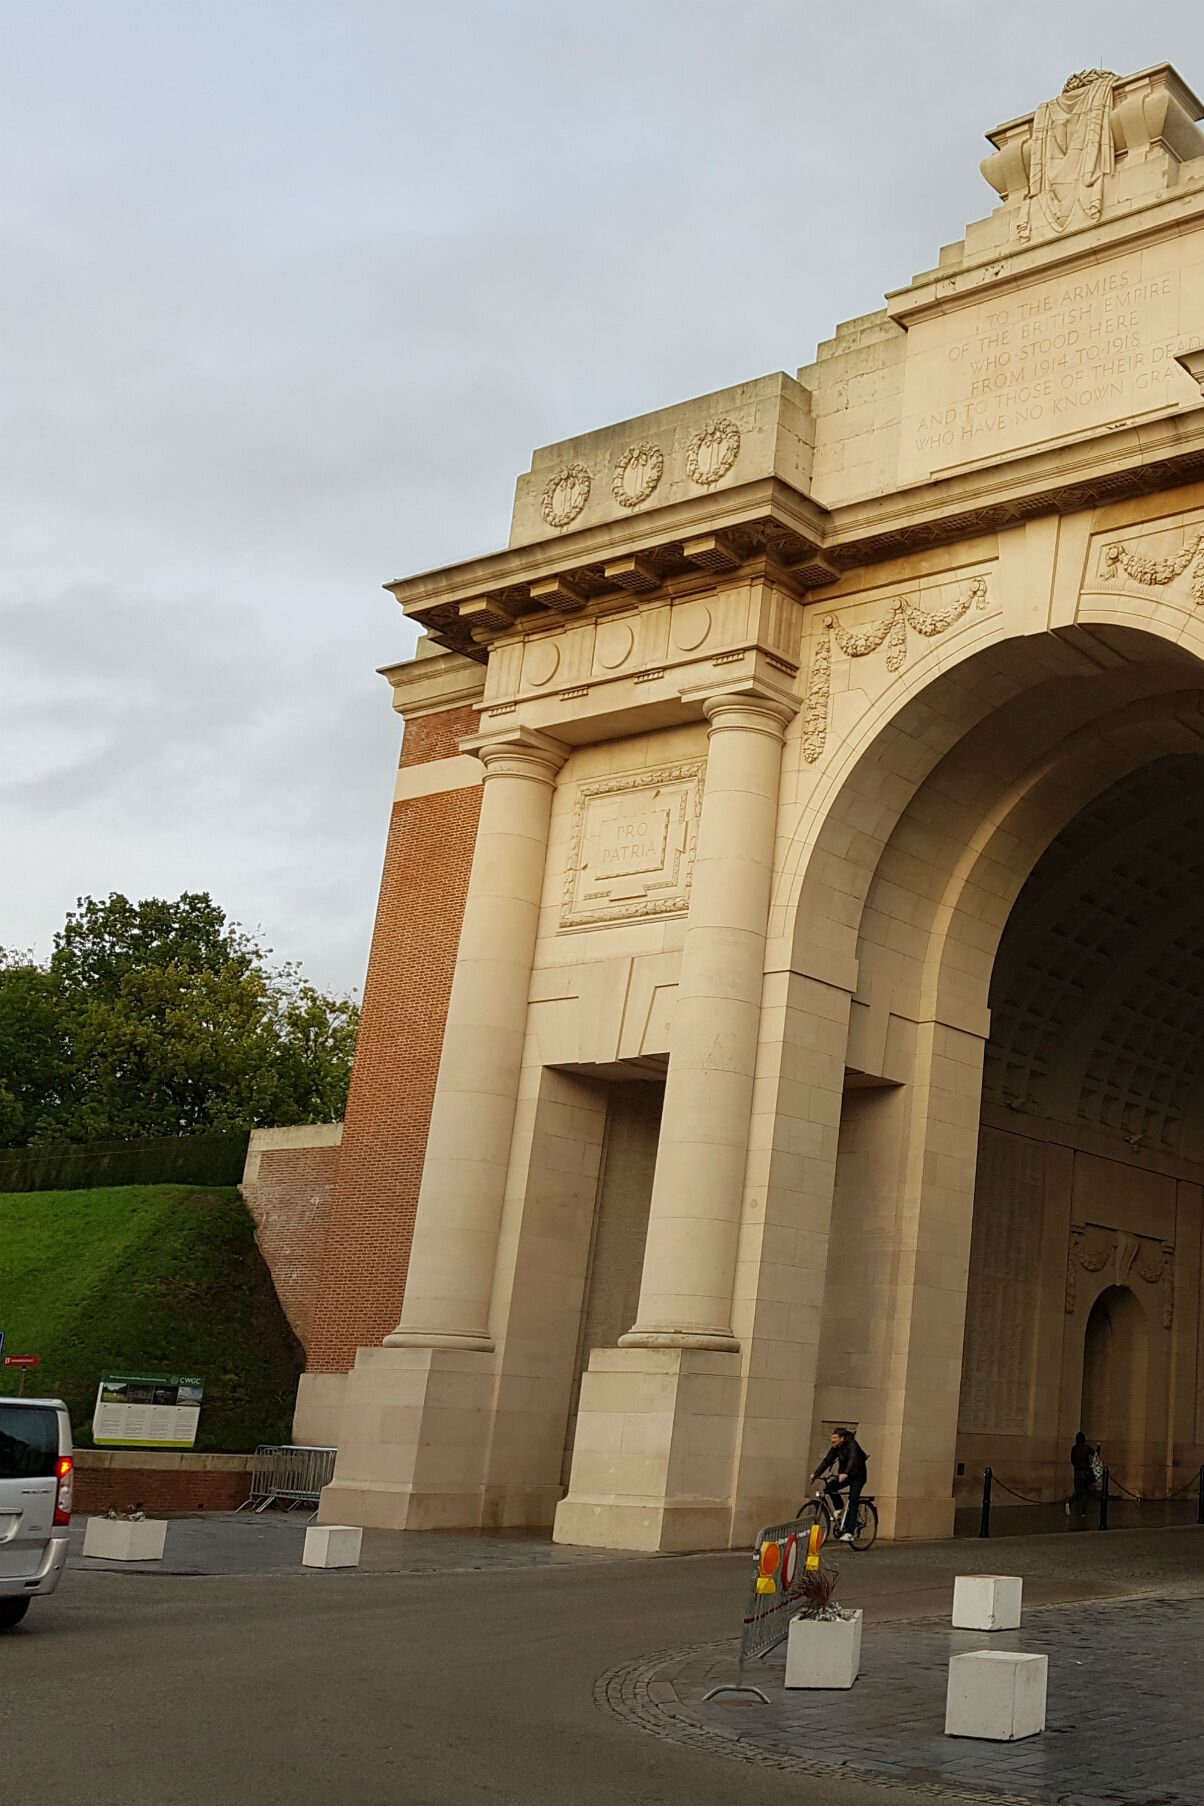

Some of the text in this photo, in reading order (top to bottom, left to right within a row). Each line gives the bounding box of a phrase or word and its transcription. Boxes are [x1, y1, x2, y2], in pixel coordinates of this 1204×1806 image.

[949, 278, 1172, 362] OF THE BRITISH EMPIRE
[986, 272, 1129, 328] TO THE ARMIES
[970, 310, 1139, 375] WHO STOOD HERE
[971, 331, 1141, 396] FROM 1914 TO 1918
[915, 430, 955, 451] WHO
[961, 415, 1006, 439] HAVE
[1015, 405, 1043, 425] NO
[1053, 380, 1124, 414] KNOWN
[918, 408, 956, 432] AND
[963, 399, 987, 419] TO
[995, 380, 1052, 409] THOSE
[1060, 370, 1084, 390] OF
[1093, 353, 1145, 380] THEIR
[603, 842, 656, 864] PATRIA
[618, 823, 648, 840] PRO
[179, 1376, 201, 1385] CWGC
